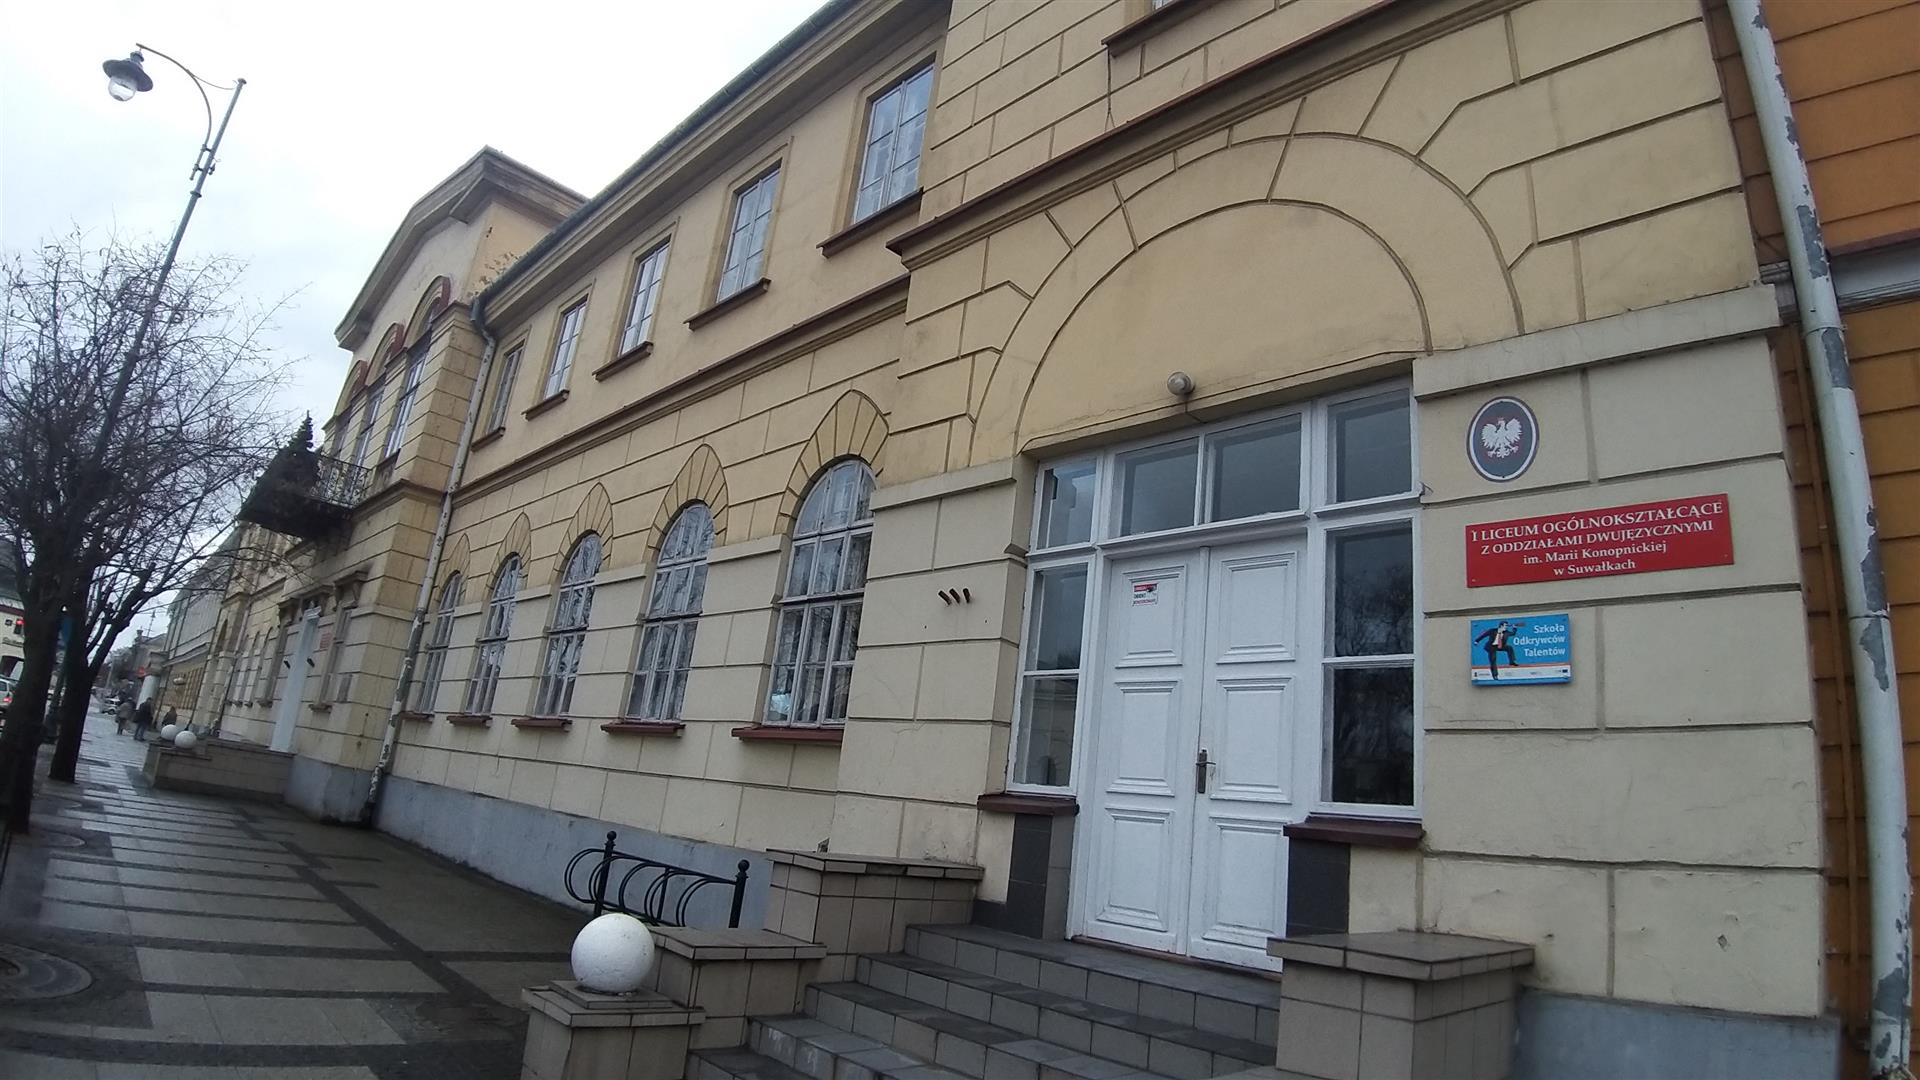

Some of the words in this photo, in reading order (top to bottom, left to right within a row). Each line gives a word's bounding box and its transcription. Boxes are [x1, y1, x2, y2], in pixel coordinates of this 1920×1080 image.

[1471, 530, 1478, 542] I
[1481, 524, 1539, 541] LICEUM
[1542, 502, 1723, 534] OGÓLNOKSZTAŁCĄCE
[1481, 545, 1490, 555] Z
[1492, 535, 1583, 554] ODDZIAŁAMI
[1586, 520, 1713, 543] DWUJĘZYCZNYMI
[1523, 554, 1543, 565] im.
[1545, 549, 1578, 562] Marii
[1582, 540, 1667, 558] Konopnickiej
[1553, 568, 1564, 576] w
[1567, 559, 1636, 575] Suwałkach
[1533, 623, 1565, 634] Szkoła
[1513, 635, 1566, 647] Odkrywców
[1524, 647, 1566, 657] Talentów
